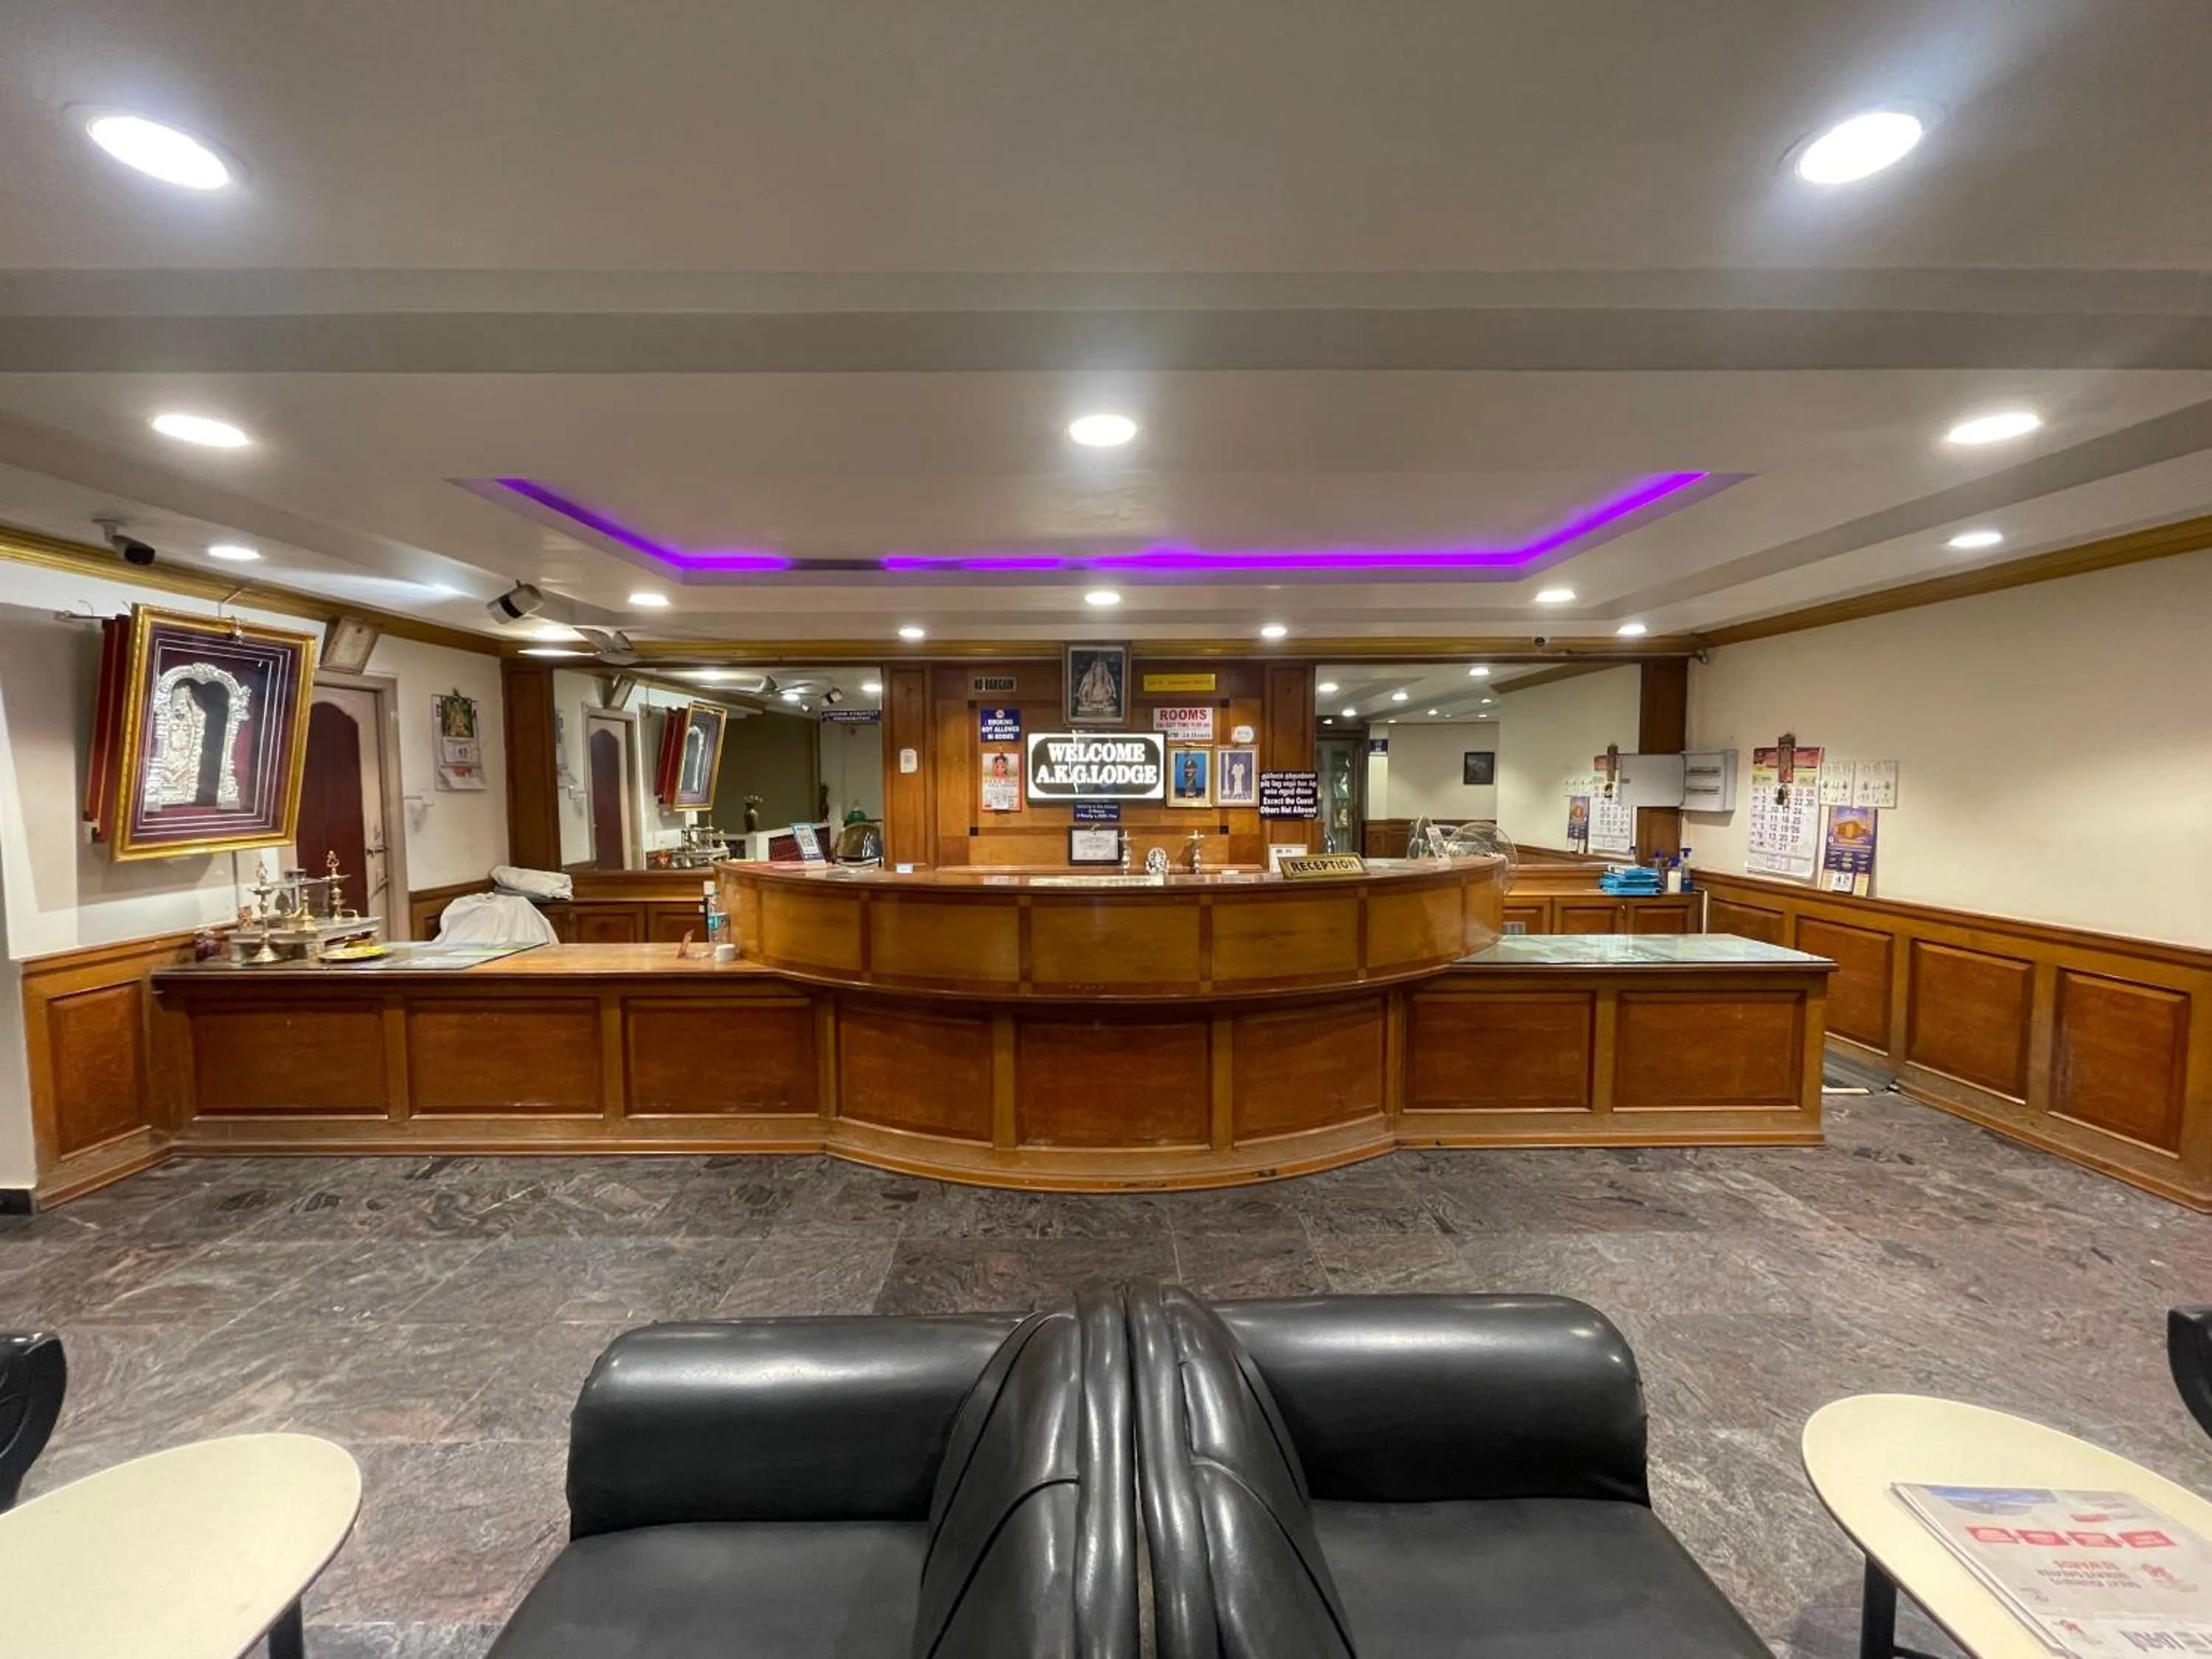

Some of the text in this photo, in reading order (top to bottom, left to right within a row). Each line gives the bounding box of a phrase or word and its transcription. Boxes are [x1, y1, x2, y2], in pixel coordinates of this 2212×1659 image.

[975, 678, 1014, 691] NO BARGAIN
[1160, 709, 1208, 720] ROOMS
[1047, 742, 1145, 762] WELCOME
[1293, 806, 1317, 814] Allowed
[1291, 860, 1357, 872] RECEPTION
